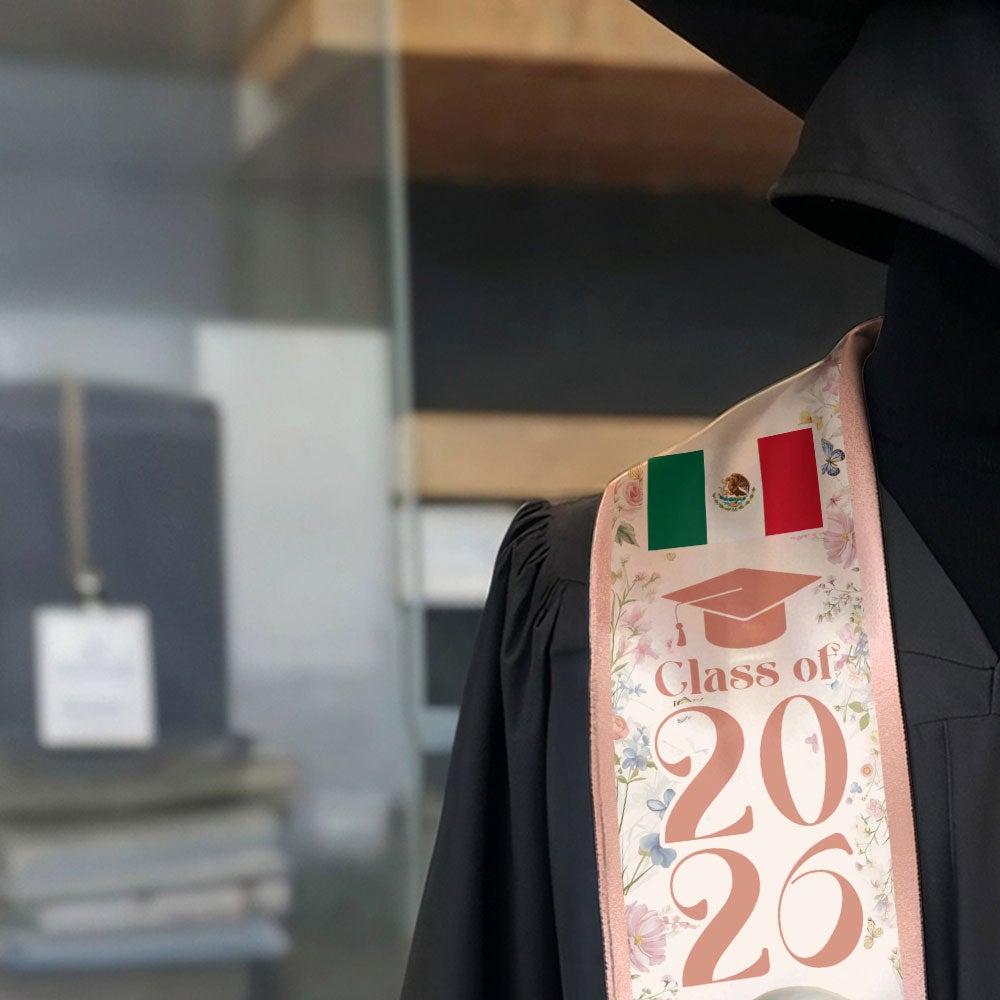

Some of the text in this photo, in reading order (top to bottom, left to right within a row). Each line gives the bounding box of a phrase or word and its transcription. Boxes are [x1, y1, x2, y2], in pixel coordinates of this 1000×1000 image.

[654, 642, 841, 698] Class of
[654, 694, 849, 844] 20
[669, 832, 864, 988] 26
